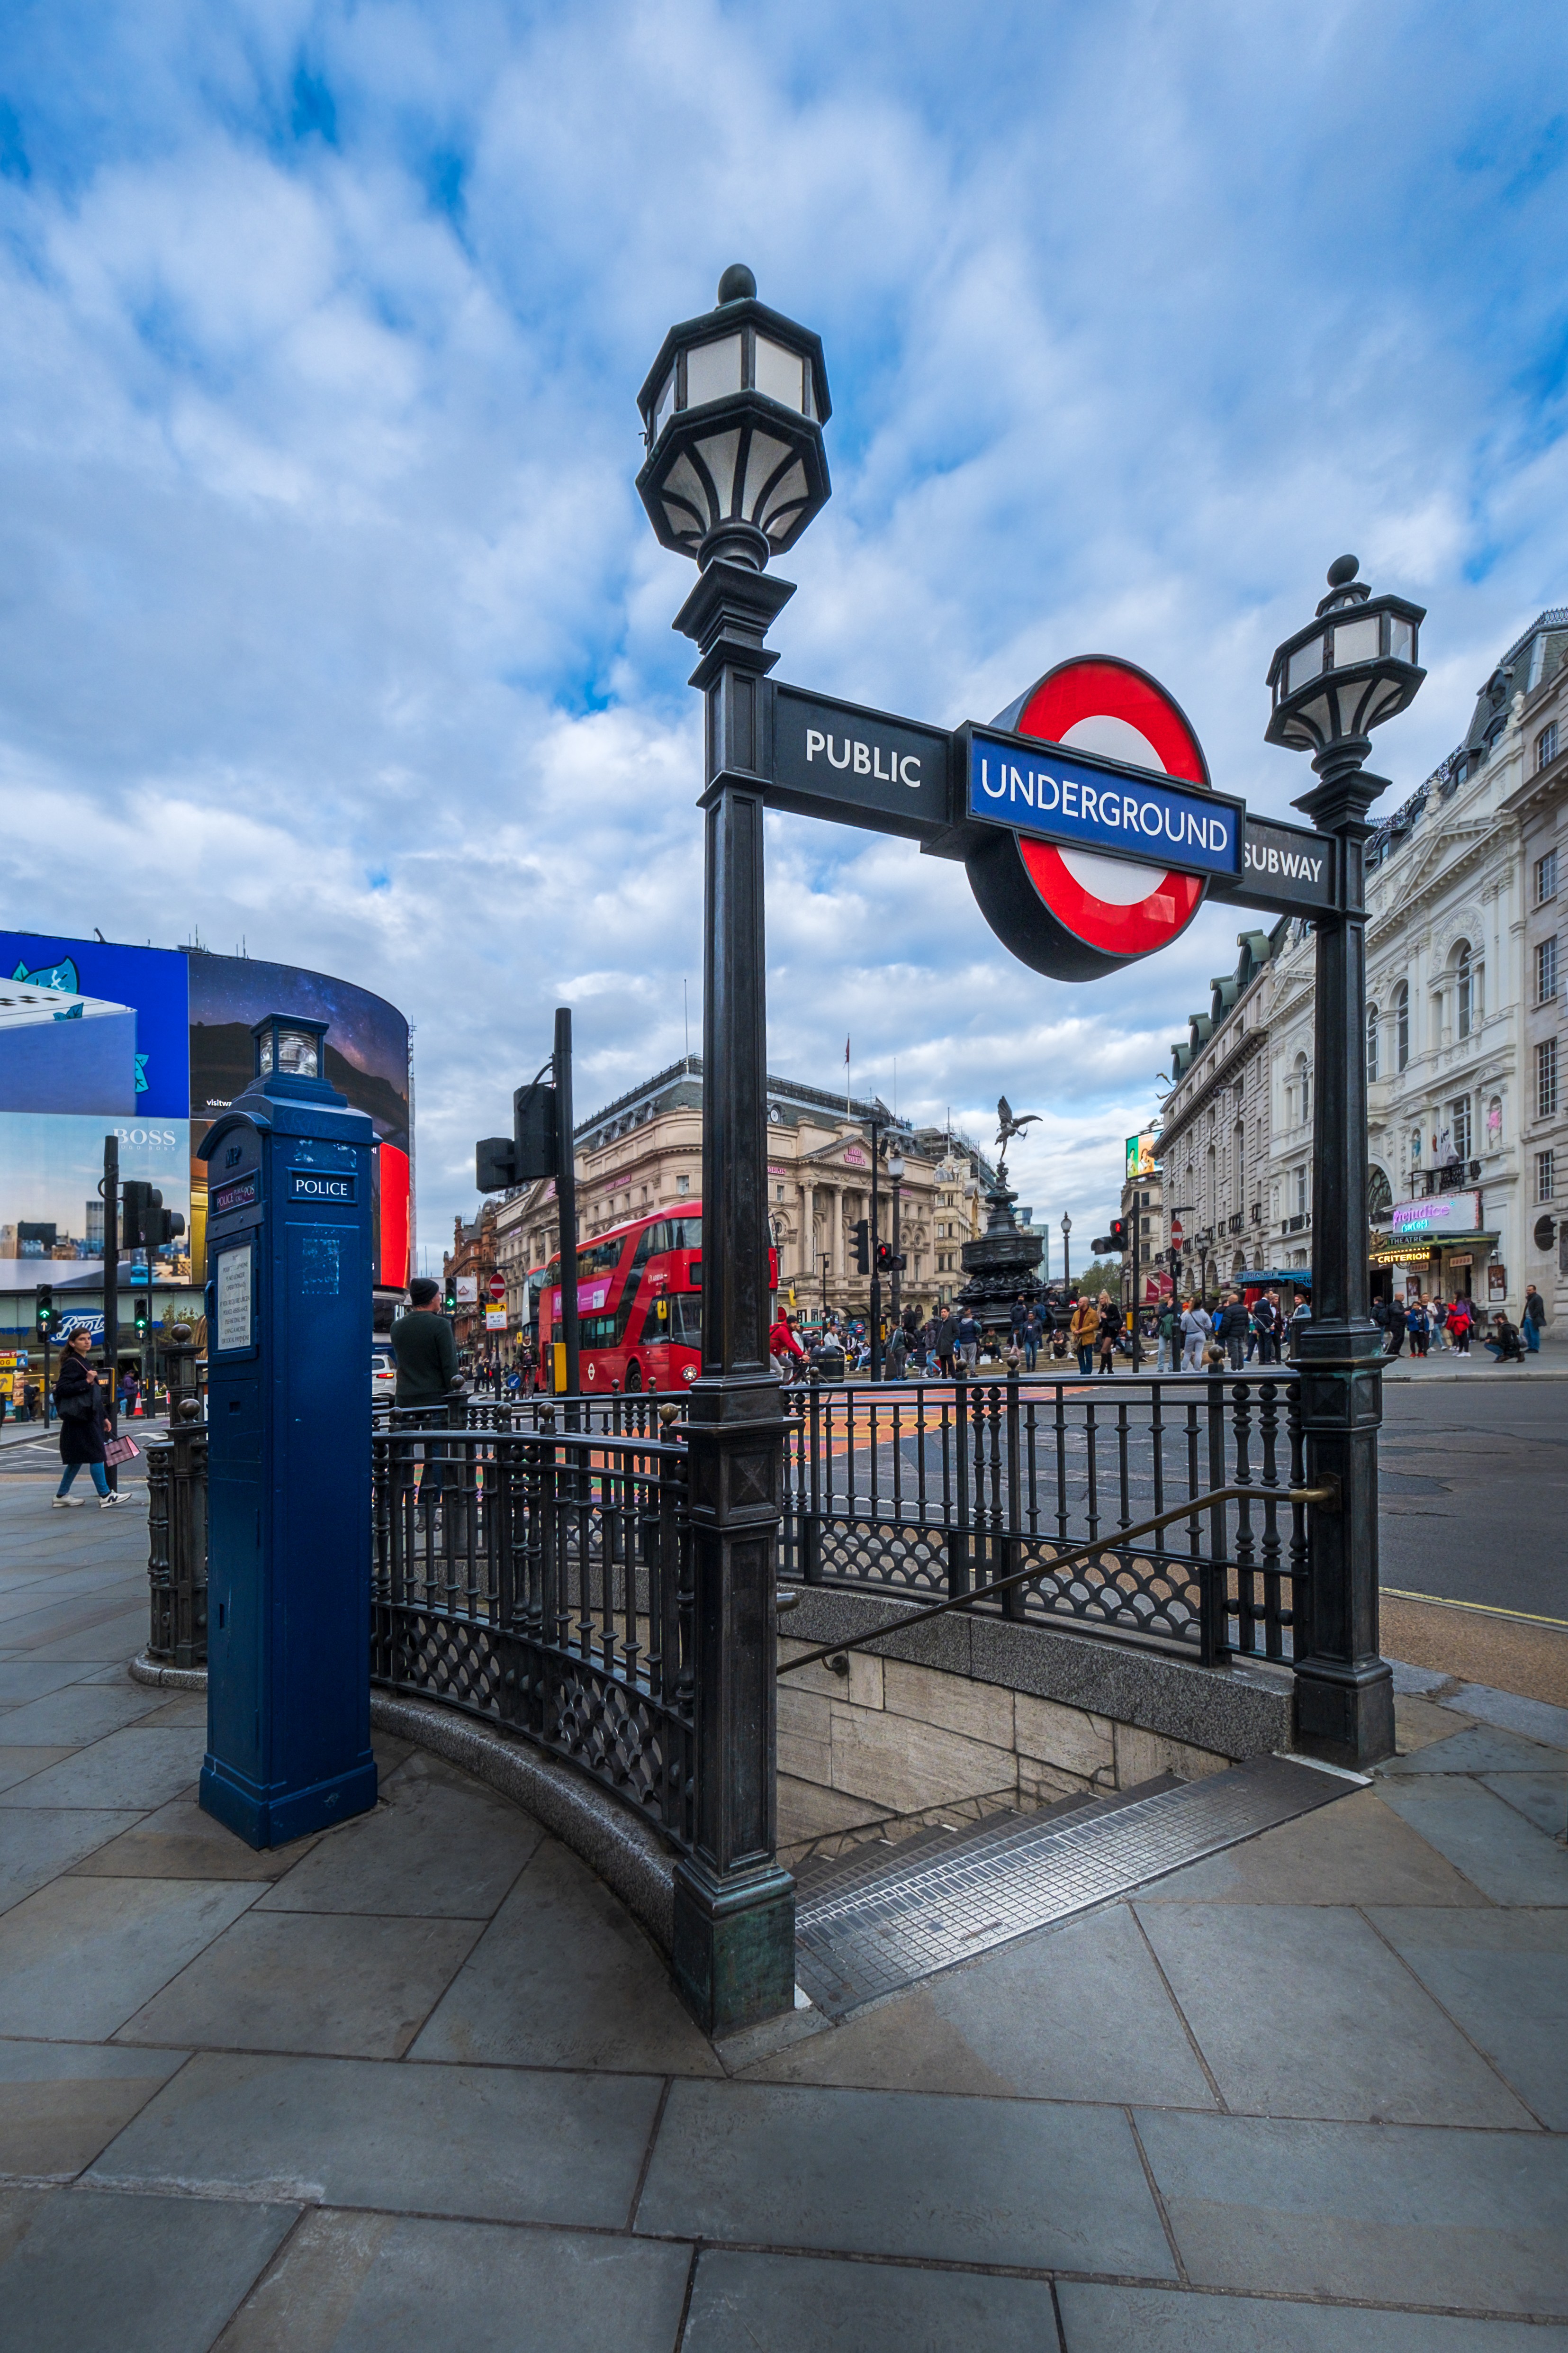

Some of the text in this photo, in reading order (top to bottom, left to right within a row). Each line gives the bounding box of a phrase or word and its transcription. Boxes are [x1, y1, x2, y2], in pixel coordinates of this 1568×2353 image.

[807, 729, 920, 787] PUBLIC
[982, 759, 1227, 851] UNDERGROUND
[1244, 842, 1322, 883] SUBWAY
[113, 1129, 176, 1145] BOSS
[844, 1154, 865, 1166] WORLDS
[848, 1148, 862, 1157] BODY
[234, 1186, 244, 1195] PUBLIC
[244, 1184, 255, 1197] POS
[296, 1179, 348, 1195] POLICE
[217, 1193, 234, 1208] POLICE
[1390, 1236, 1424, 1245] THEATRE
[1378, 1252, 1430, 1263] CRITERION
[51, 1314, 105, 1341] Boot
